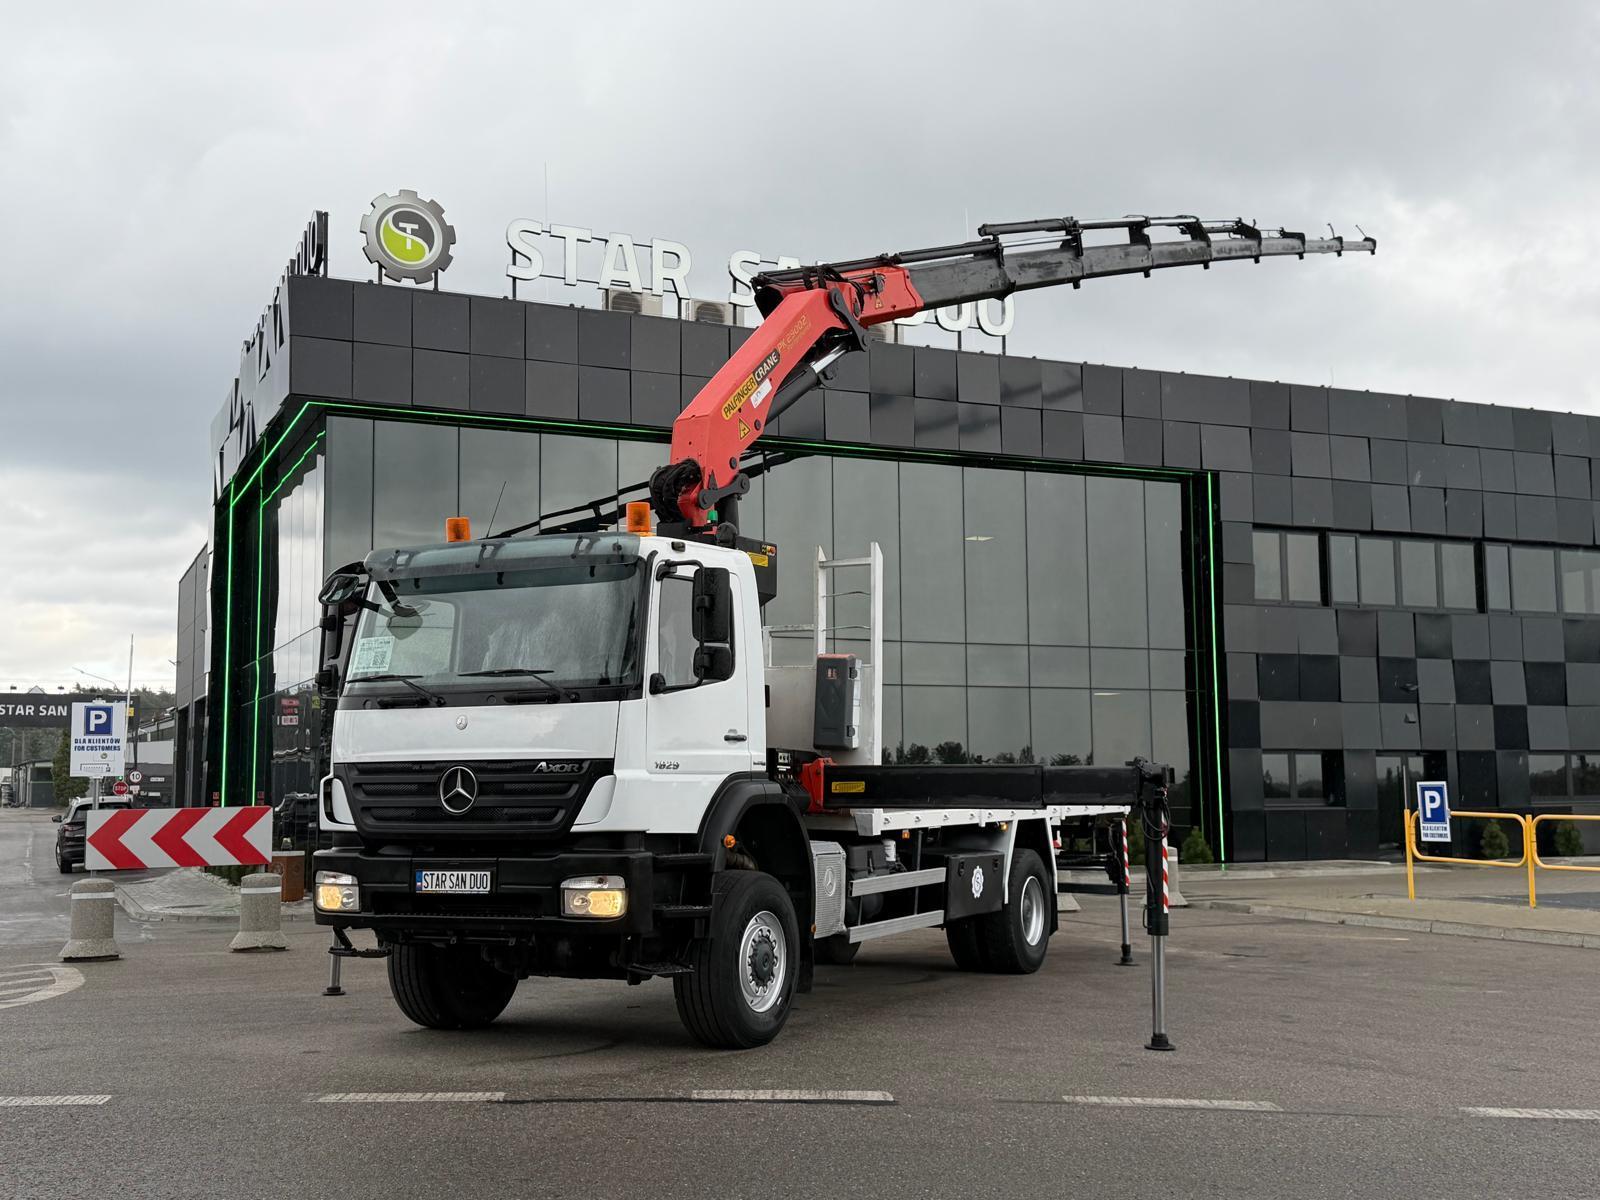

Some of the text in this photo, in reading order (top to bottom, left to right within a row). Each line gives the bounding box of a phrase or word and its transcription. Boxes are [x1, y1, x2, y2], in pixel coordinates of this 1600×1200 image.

[506, 218, 692, 300] STAR
[723, 376, 757, 418] PALFINGER
[754, 351, 779, 382] CRANE
[0, 704, 68, 716] STAR SAN
[89, 711, 108, 732] P
[655, 761, 680, 770] 1829
[1424, 790, 1441, 818] P
[423, 873, 488, 889] STAR SAN DUO
